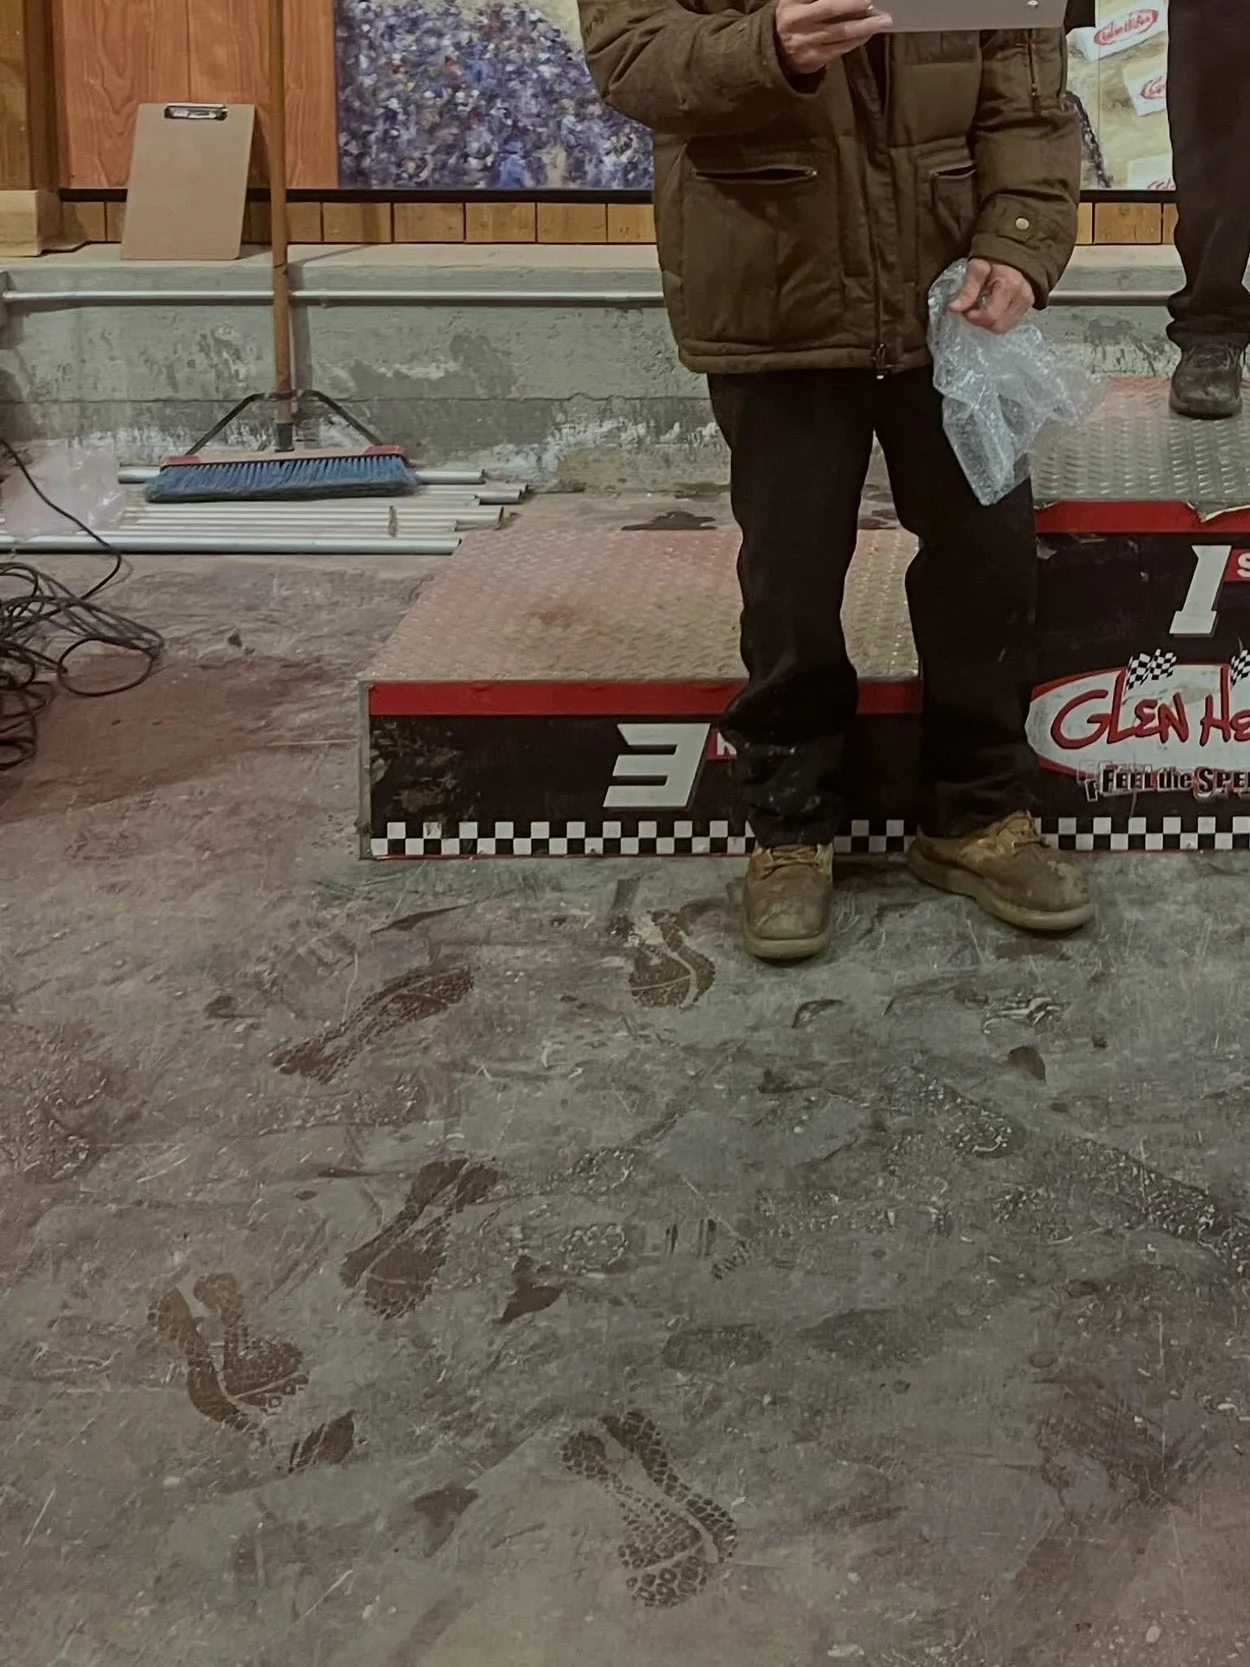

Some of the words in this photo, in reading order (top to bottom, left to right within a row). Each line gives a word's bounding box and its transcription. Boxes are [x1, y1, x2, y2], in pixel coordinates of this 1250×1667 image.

[1050, 666, 1189, 751] GLEN
[1101, 767, 1152, 793] FEEL
[1157, 766, 1193, 790] the
